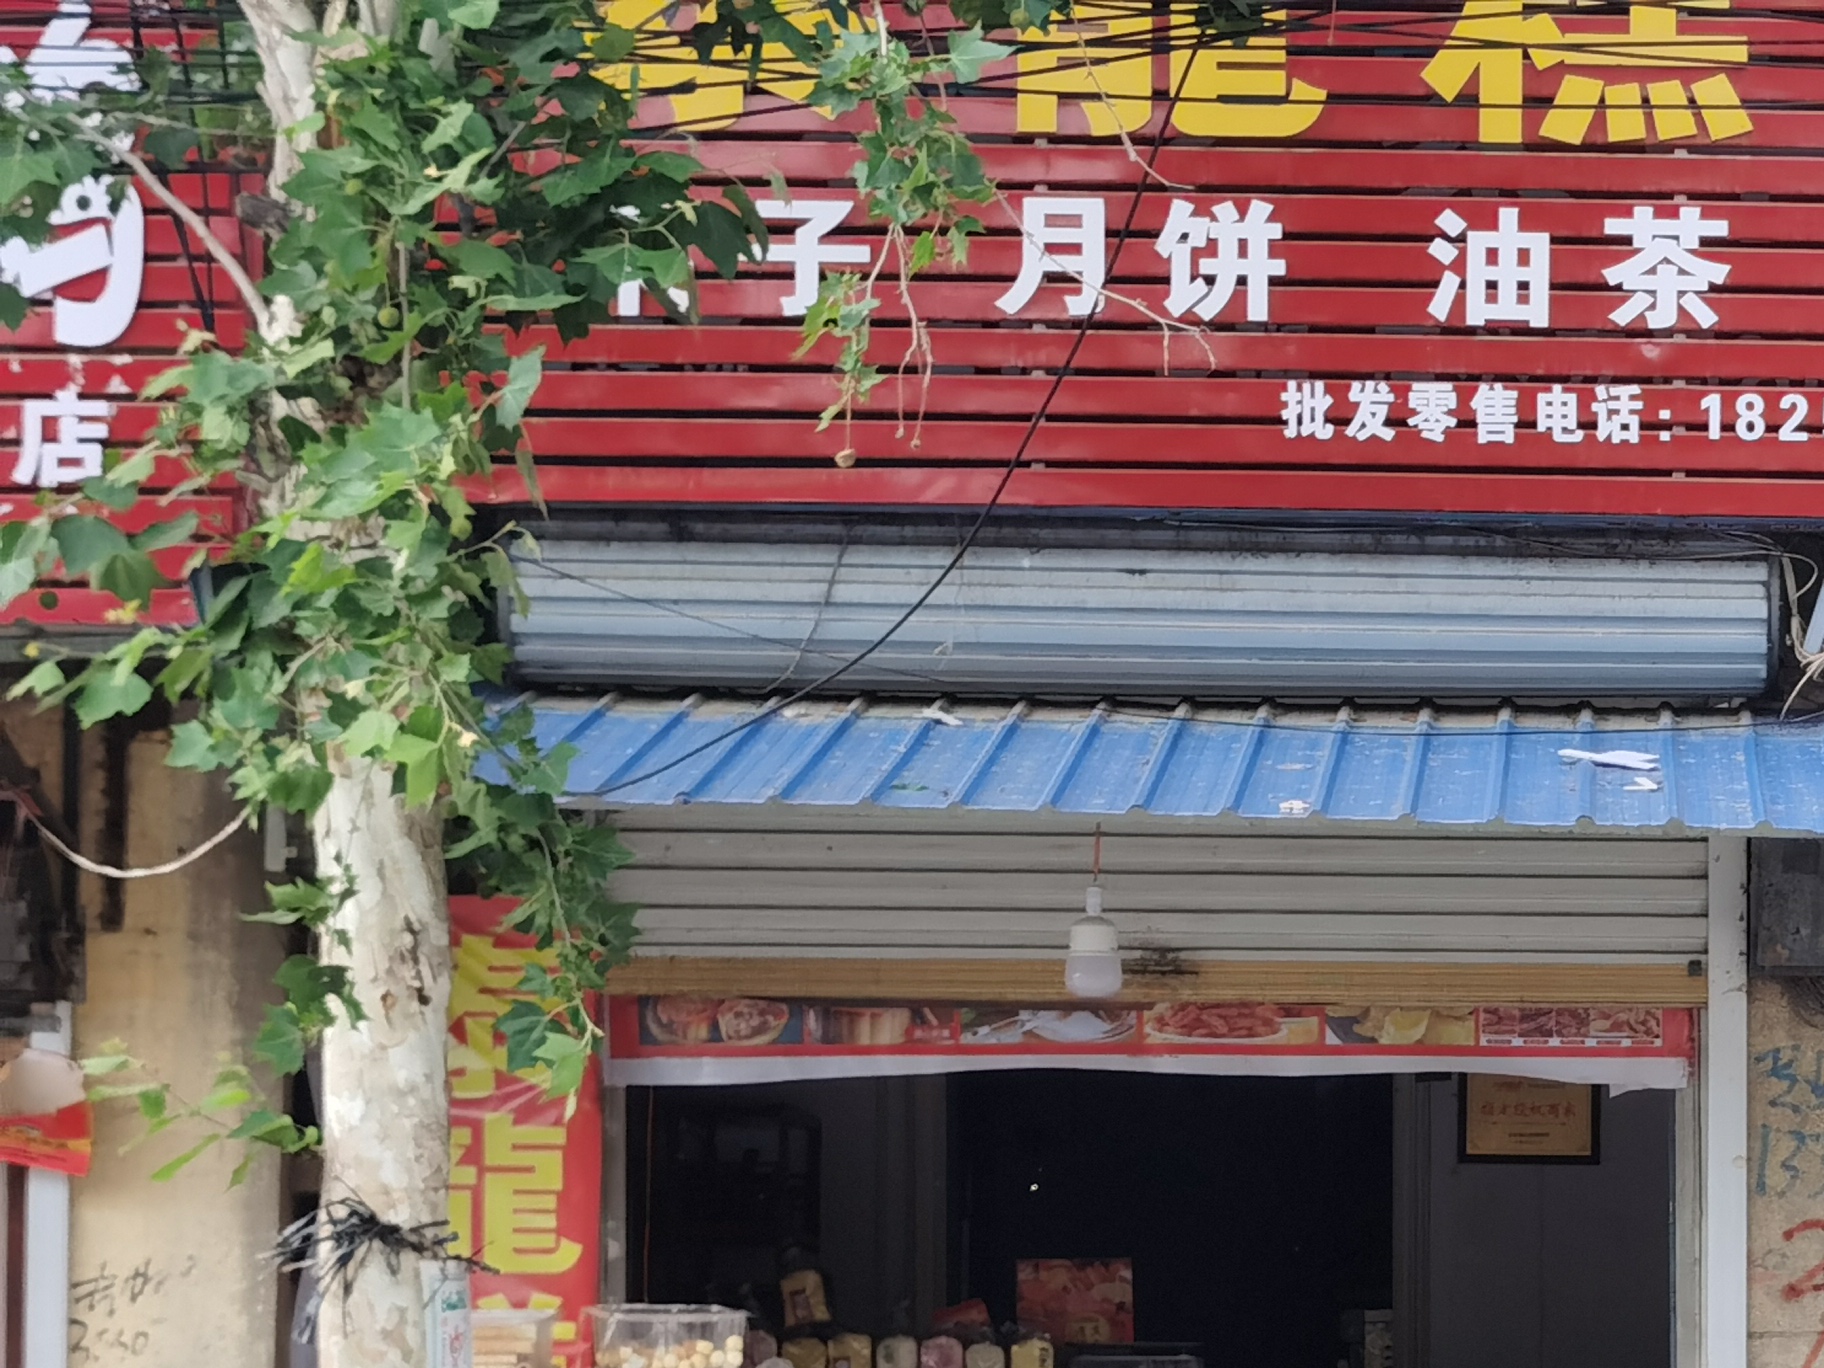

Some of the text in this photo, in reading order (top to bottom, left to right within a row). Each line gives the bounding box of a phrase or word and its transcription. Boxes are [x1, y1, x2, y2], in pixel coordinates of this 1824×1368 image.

[608, 200, 870, 318] 子
[994, 196, 1286, 323] 月饼
[1426, 205, 1731, 330] 油茶
[12, 390, 118, 488] 店
